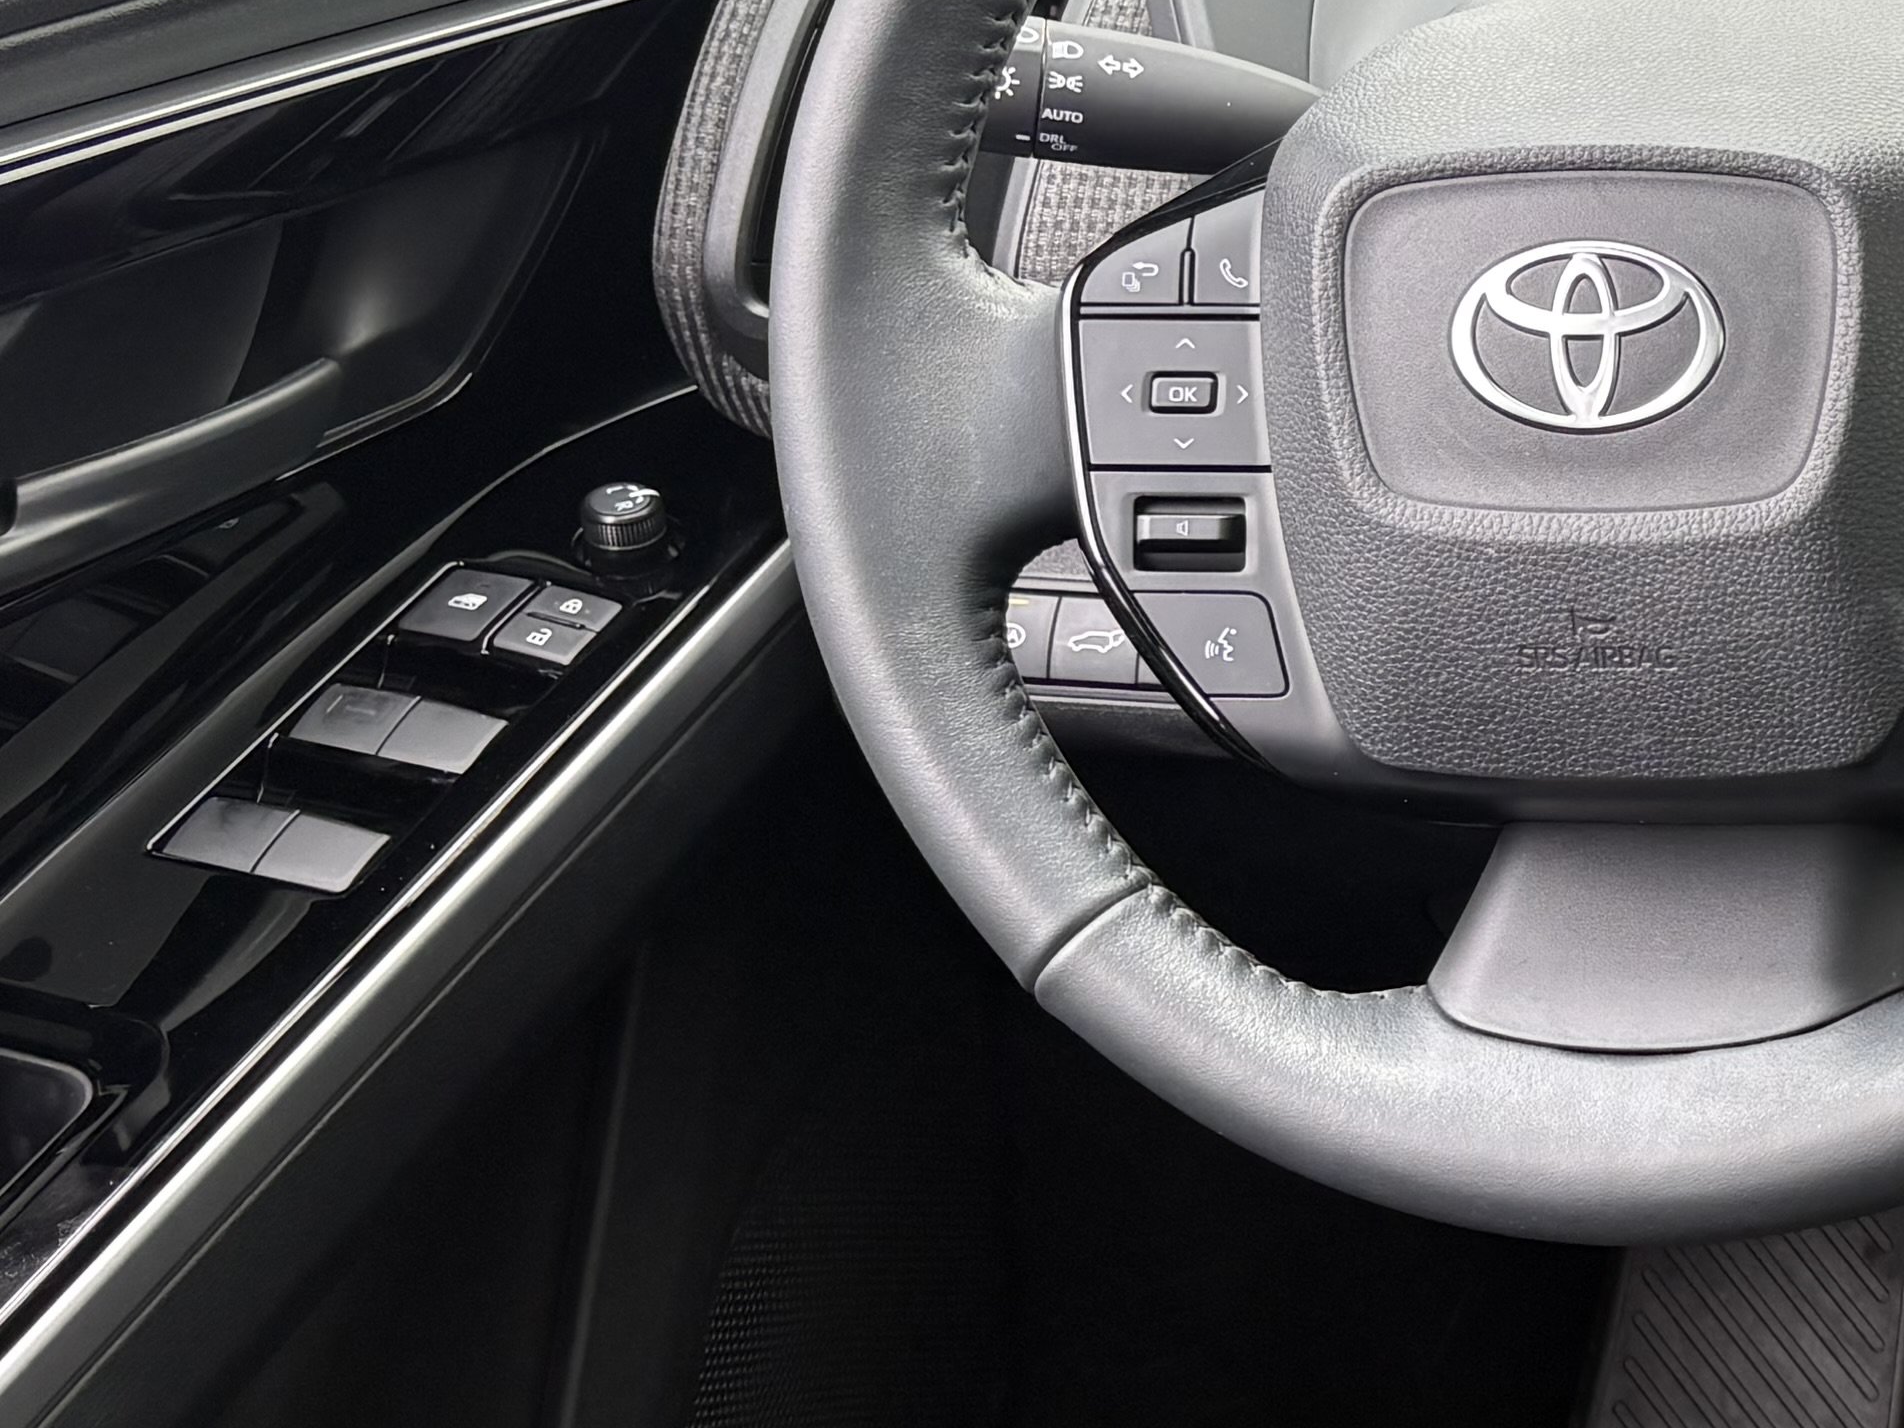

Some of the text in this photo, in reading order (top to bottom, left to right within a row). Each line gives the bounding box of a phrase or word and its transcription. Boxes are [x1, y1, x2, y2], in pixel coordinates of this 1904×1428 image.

[1041, 108, 1084, 124] AUTO
[1039, 131, 1066, 144] DRL
[1051, 142, 1078, 153] OFF
[1168, 385, 1197, 403] OK
